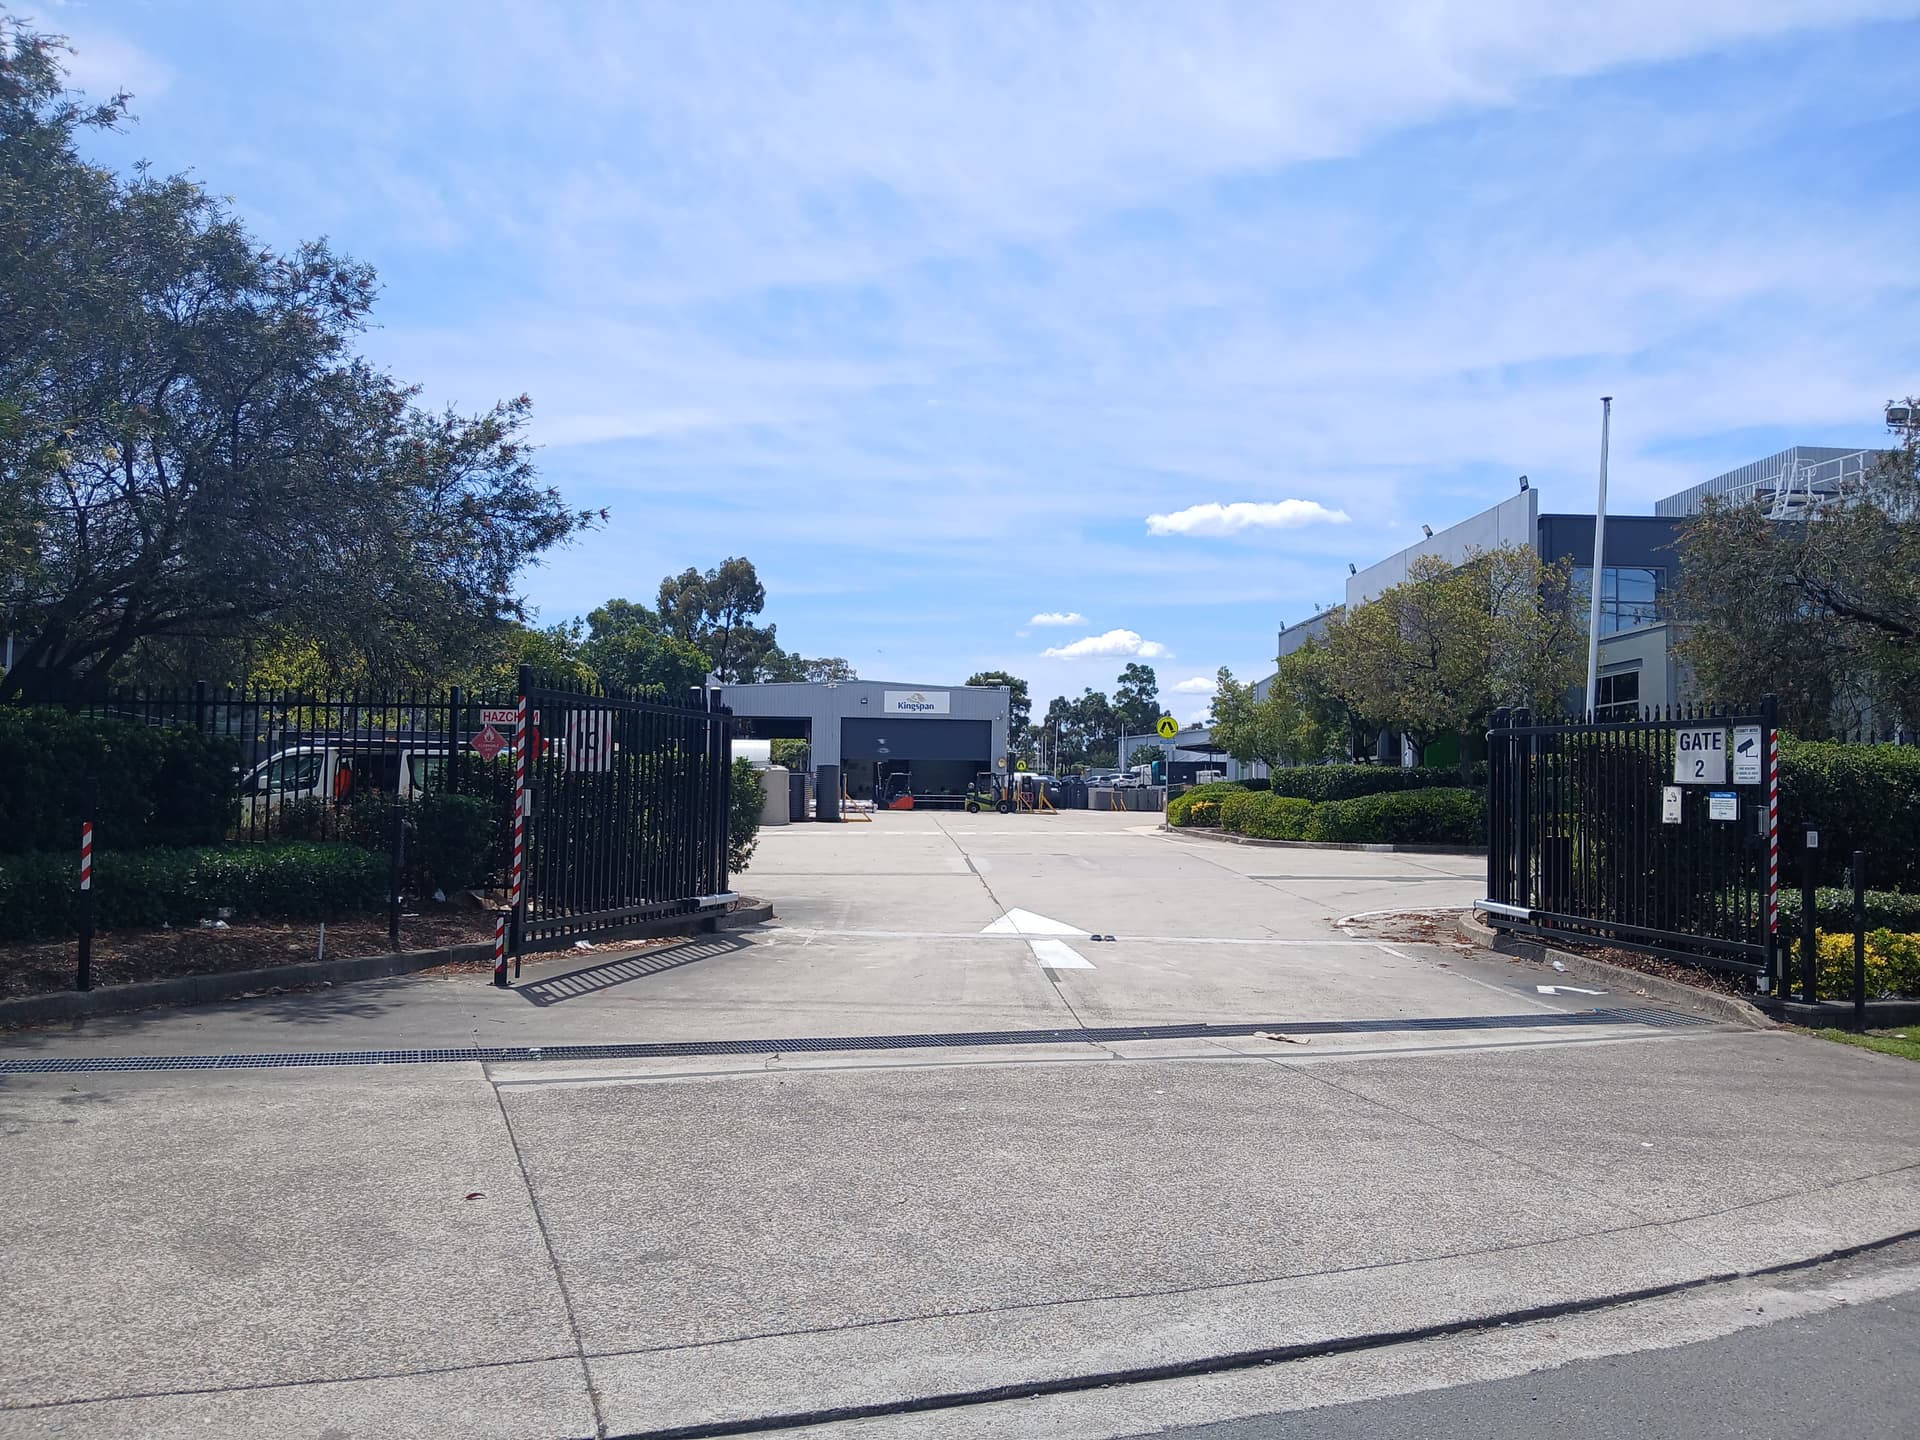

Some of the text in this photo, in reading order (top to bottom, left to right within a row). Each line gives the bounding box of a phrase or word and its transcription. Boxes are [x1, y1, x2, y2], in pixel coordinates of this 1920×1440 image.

[897, 701, 935, 712] Kingspan
[483, 711, 539, 722] HAZCHM
[1679, 732, 1722, 751] GATE
[1695, 759, 1705, 778] 2
